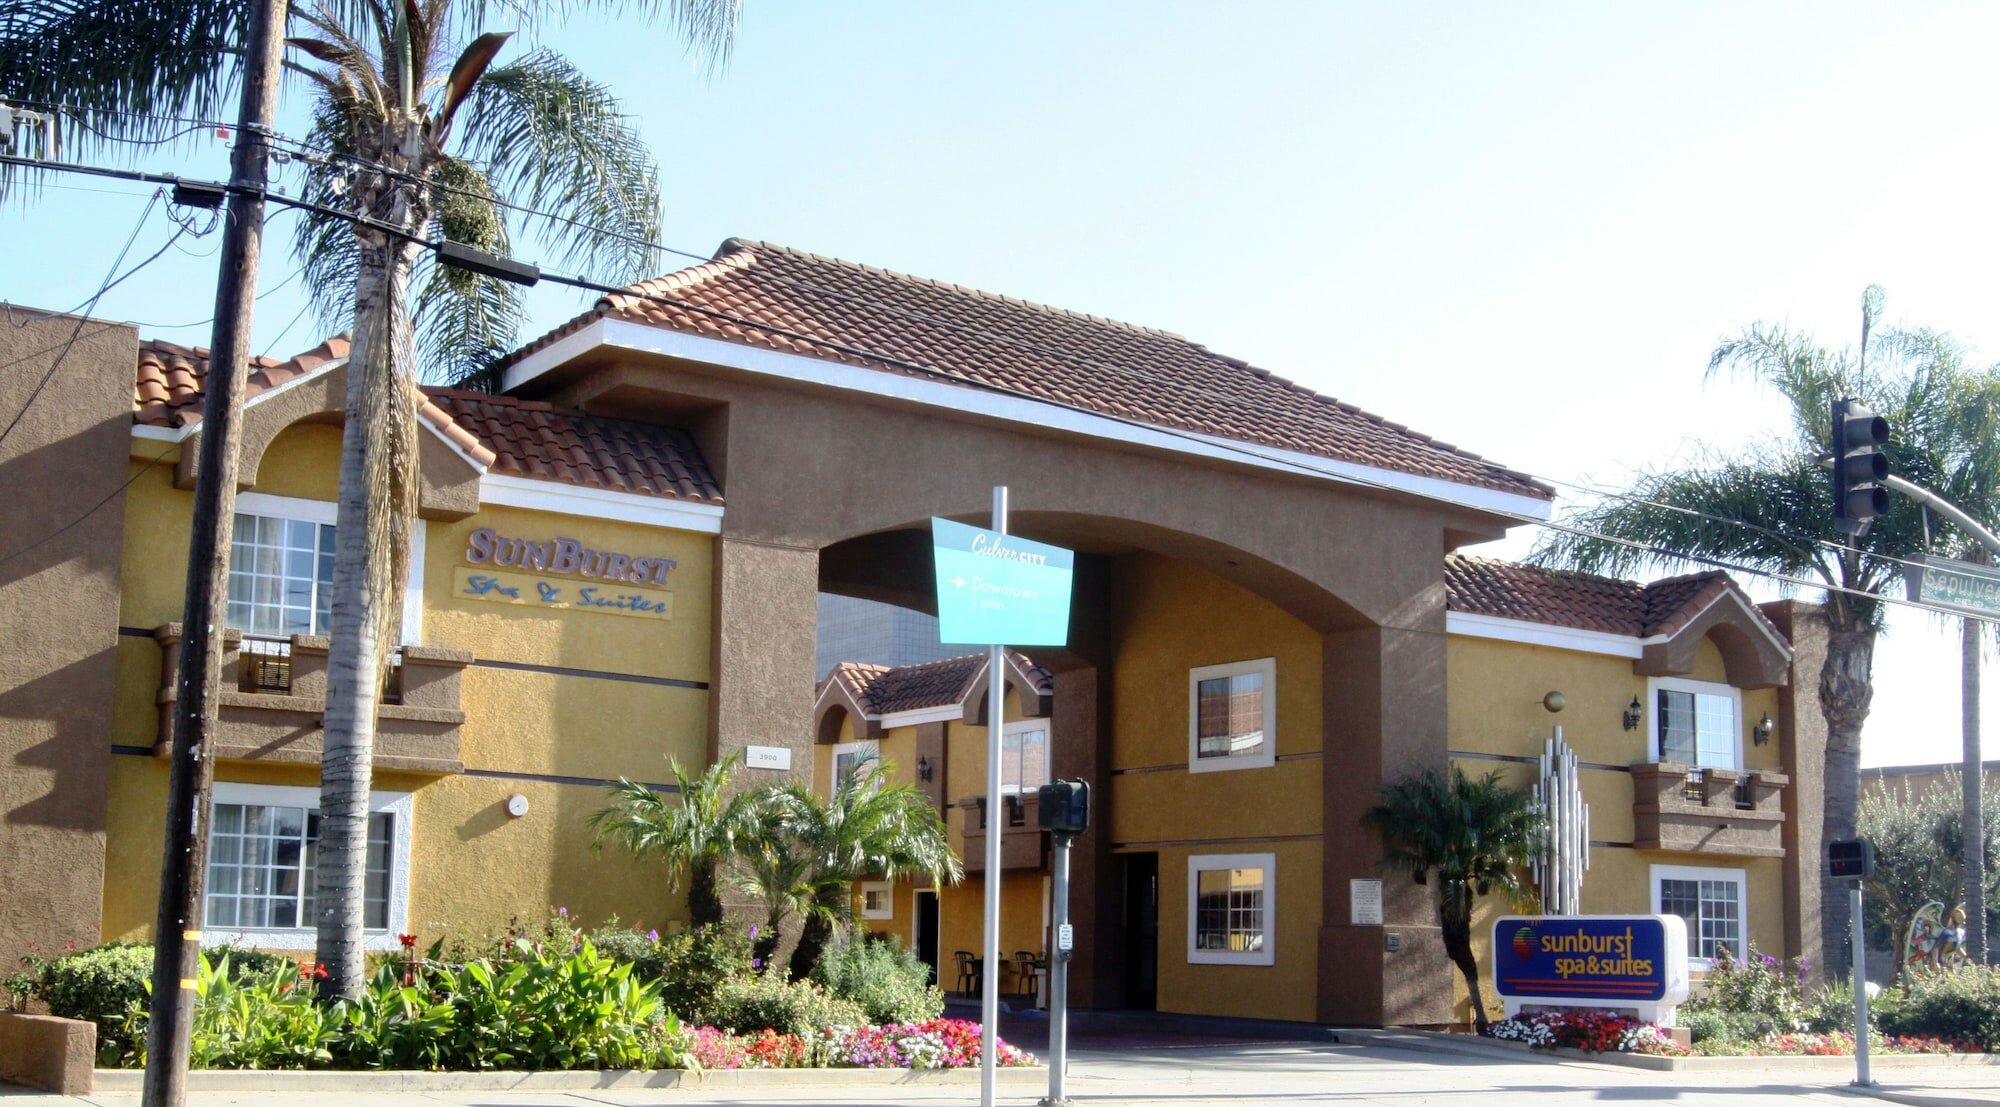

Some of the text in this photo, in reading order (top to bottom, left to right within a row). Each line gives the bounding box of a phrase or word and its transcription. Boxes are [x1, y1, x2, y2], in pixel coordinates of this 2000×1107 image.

[972, 534, 1046, 566] Culver CITY
[537, 581, 561, 602] &
[577, 587, 666, 613] Suites
[972, 576, 1039, 600] Downtown
[1541, 926, 1633, 957] sunburst
